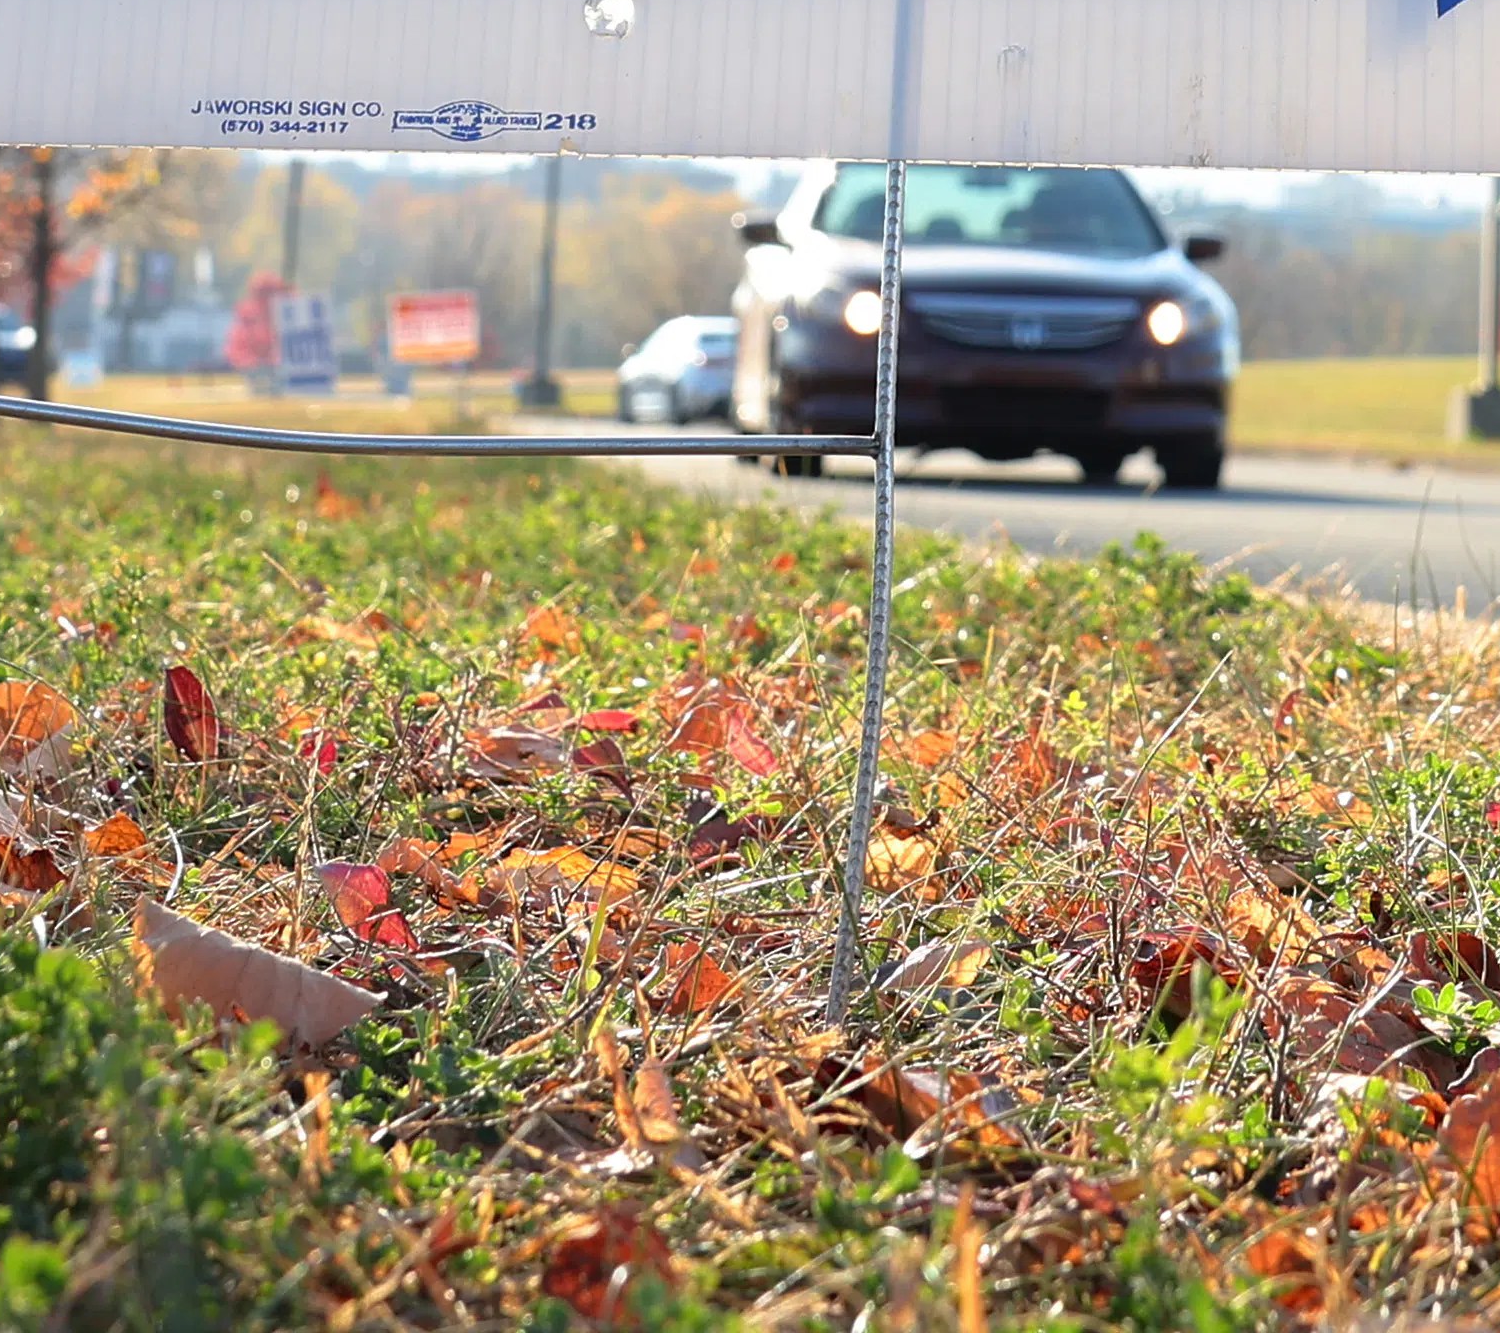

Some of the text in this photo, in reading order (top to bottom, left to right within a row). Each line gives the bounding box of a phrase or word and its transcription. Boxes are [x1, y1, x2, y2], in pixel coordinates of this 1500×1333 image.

[191, 99, 385, 118] JAWORSKI SIGN CO.
[221, 119, 349, 134] (570) 344-2117
[543, 113, 597, 131] 218
